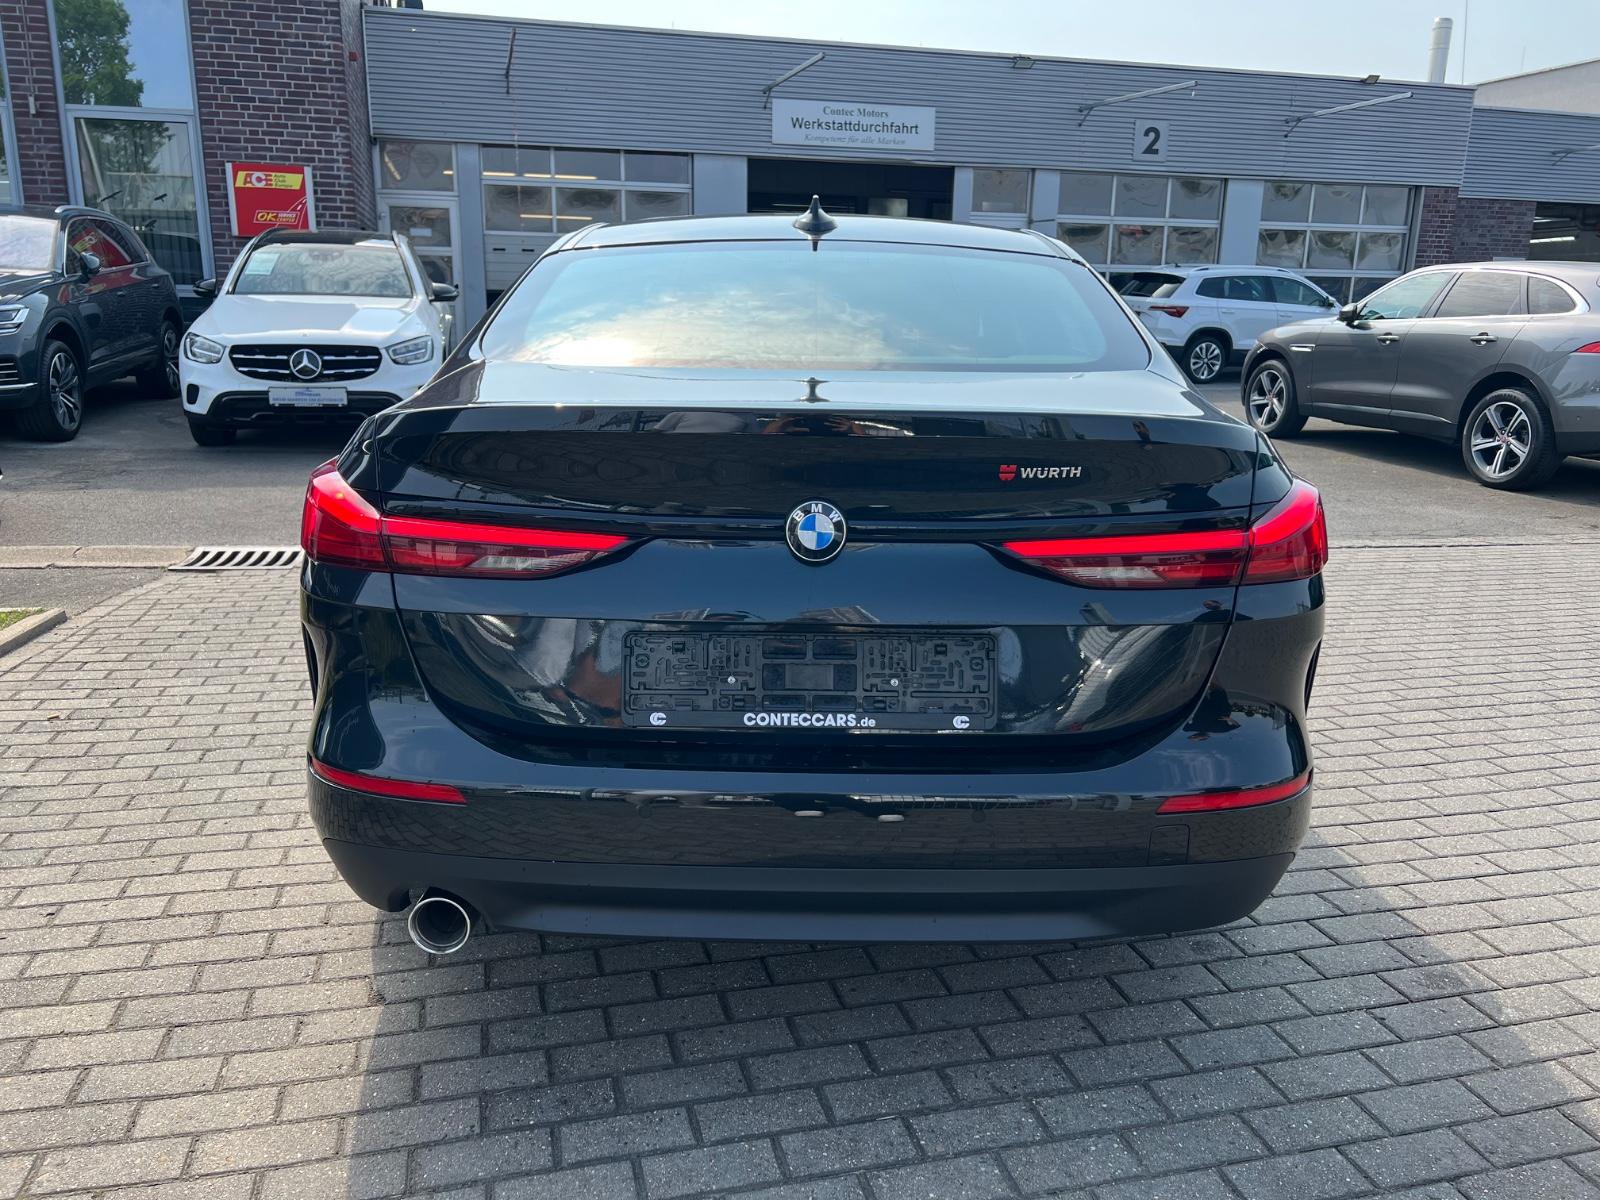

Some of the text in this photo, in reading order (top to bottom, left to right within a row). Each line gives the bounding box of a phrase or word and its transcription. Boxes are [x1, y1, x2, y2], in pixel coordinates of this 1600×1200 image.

[823, 105, 889, 118] Contec Motors
[790, 116, 919, 134] Werkstattdurchfahrt
[860, 136, 876, 145] alle
[877, 137, 906, 146] Marken
[1141, 126, 1161, 154] 2
[257, 212, 277, 221] OK
[1020, 466, 1082, 479] WÜRTH
[792, 503, 842, 523] BMW
[743, 711, 877, 729] CONTECCARS.de
